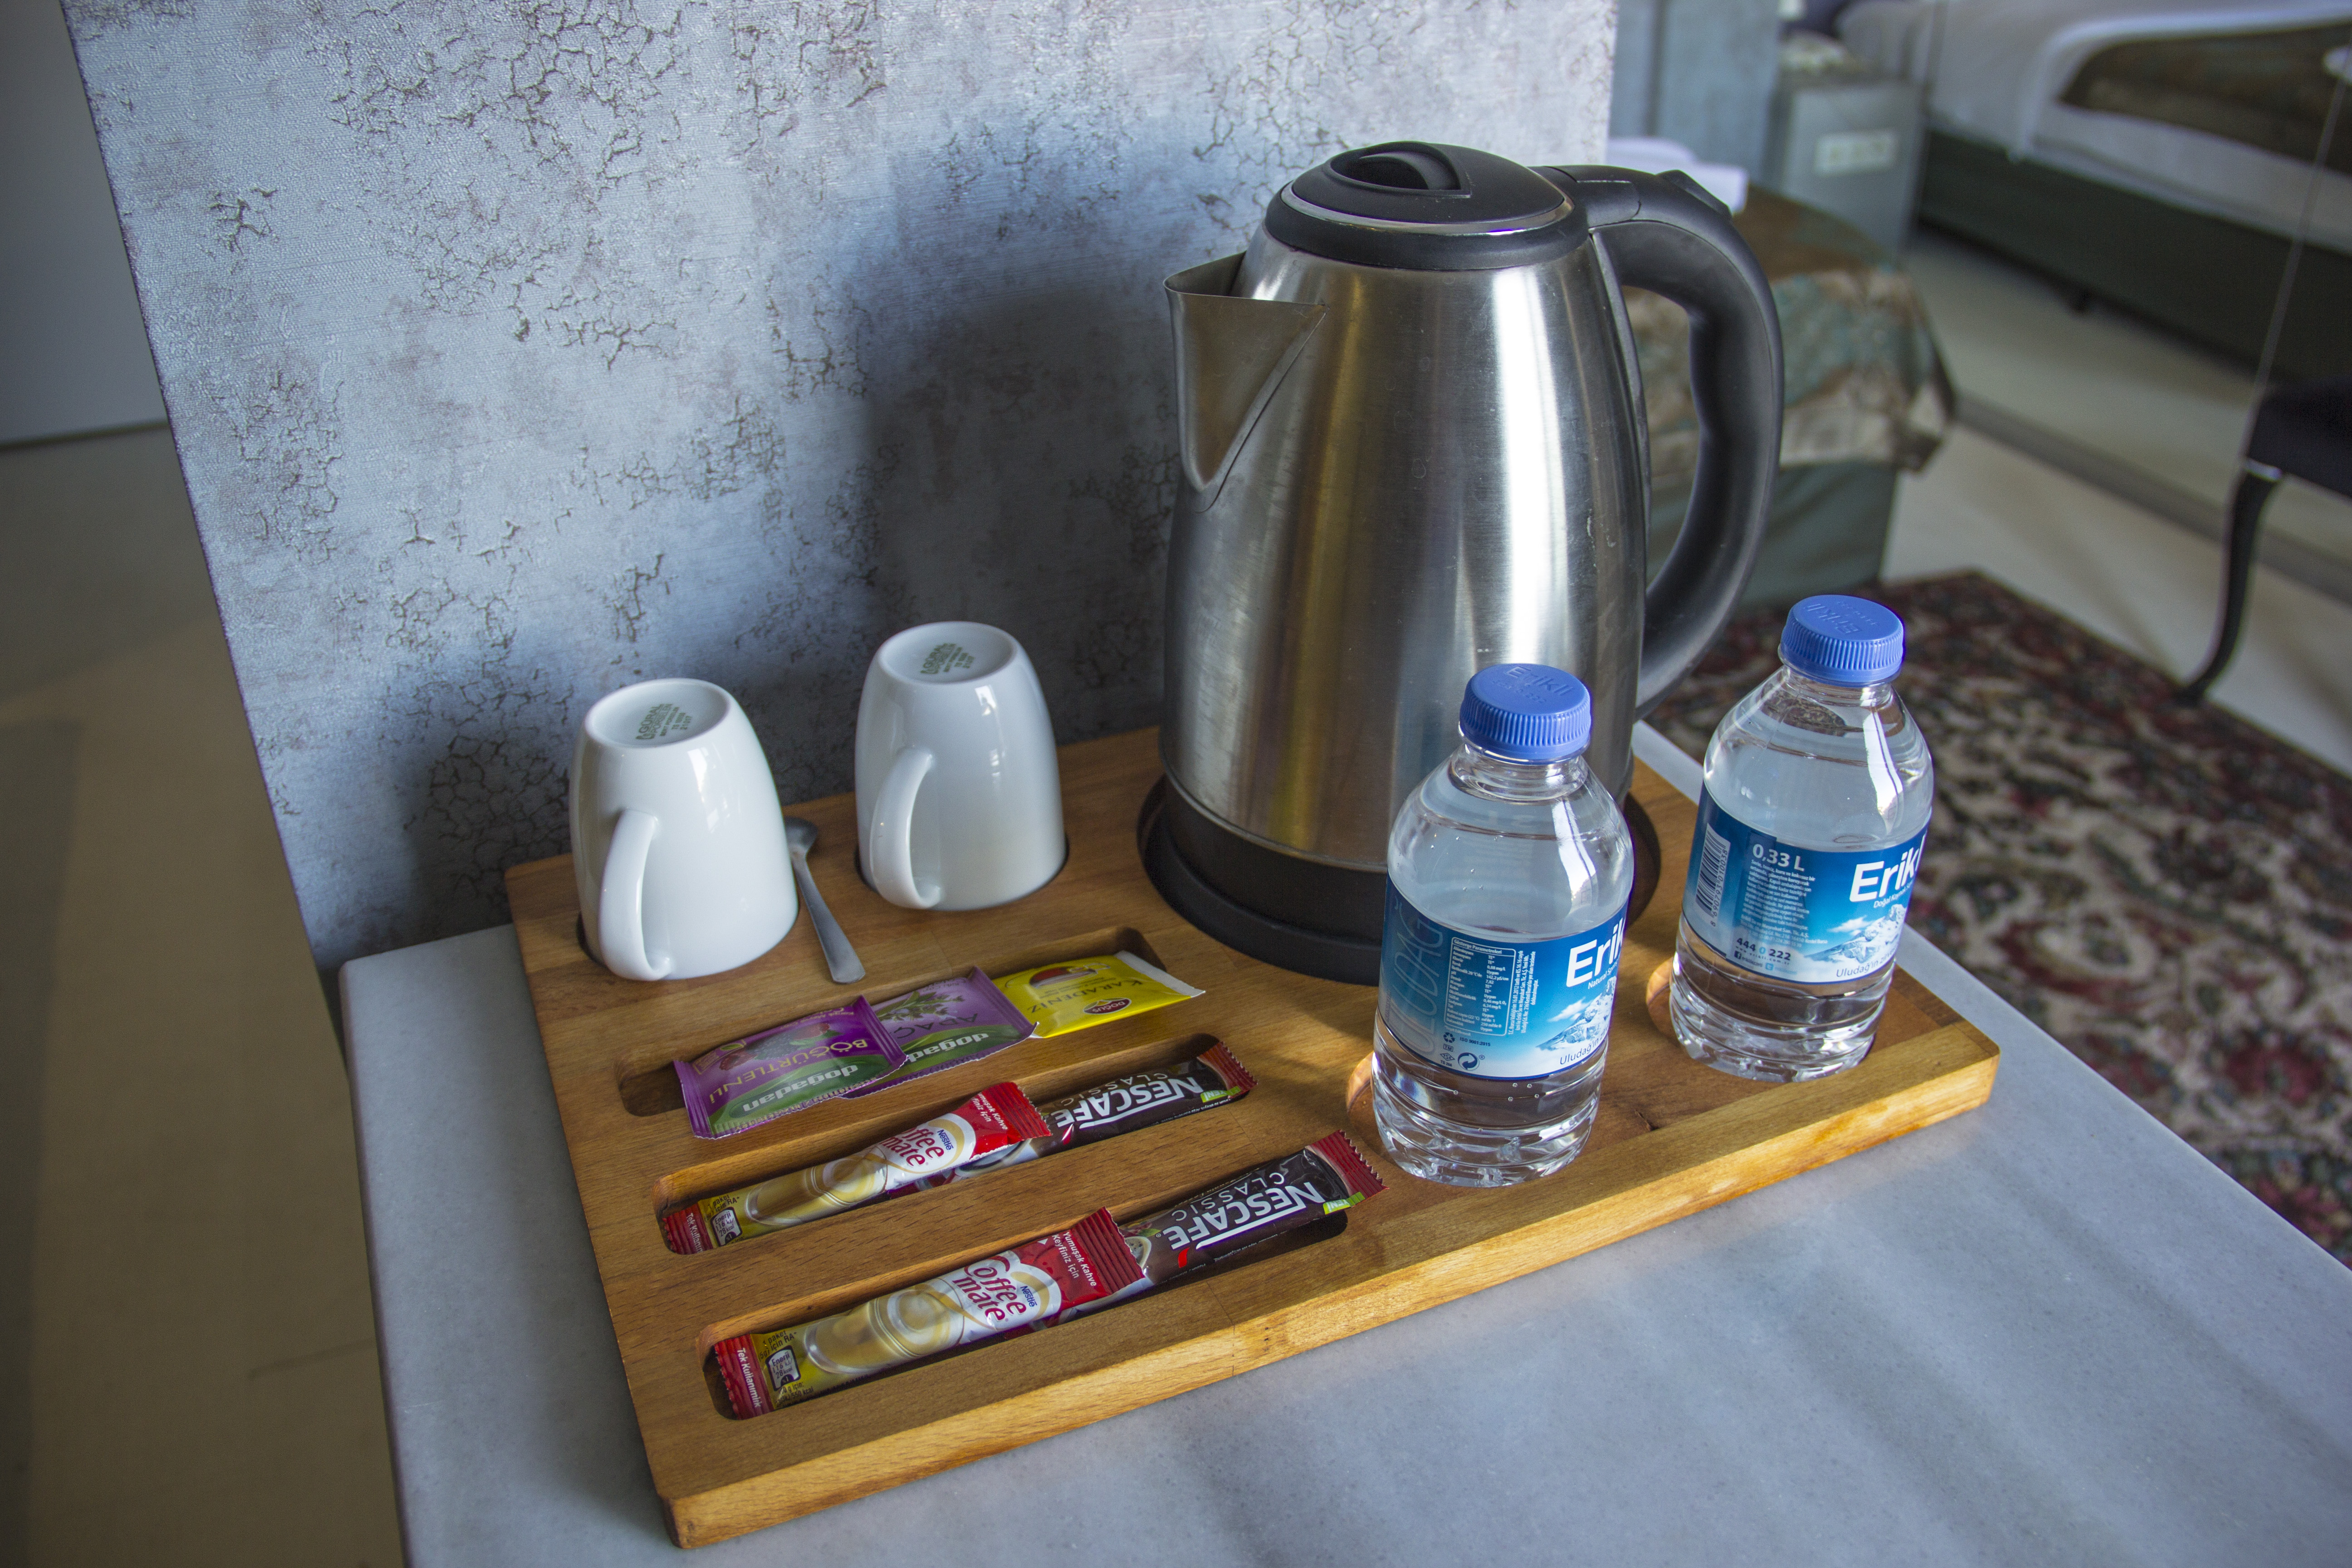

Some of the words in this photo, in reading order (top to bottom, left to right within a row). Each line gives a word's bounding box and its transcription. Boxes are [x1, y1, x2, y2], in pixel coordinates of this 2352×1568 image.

[1752, 844, 1790, 867] 0,33
[1793, 857, 1805, 872] L
[1472, 945, 1503, 955] Parametreleri
[1736, 936, 1756, 952] 444
[1759, 946, 1766, 955] 0
[1769, 947, 1791, 961] 222
[1588, 970, 1607, 989] Natural
[1027, 980, 1143, 1013] KARADENİZ
[1560, 1036, 1600, 1066] Uludağ'ın
[710, 1039, 868, 1103] BÖĞÜRTLENLİ
[743, 1065, 858, 1112] doğadan
[1061, 1073, 1168, 1106] CLASSIC
[971, 1098, 984, 1110] finiz
[980, 1111, 992, 1122] için
[992, 1113, 1008, 1130] Kahve
[879, 1137, 926, 1166] mate
[902, 1127, 944, 1158] ffee
[1171, 1172, 1285, 1222] CLASSIC
[686, 1213, 695, 1226] Tek
[715, 1211, 731, 1224] Enerji
[715, 1220, 725, 1231] 116
[1052, 1235, 1071, 1263] Keyfiniz
[1068, 1264, 1079, 1278] için
[1063, 1232, 1084, 1263] Yumuşak
[1080, 1264, 1097, 1286] Kahve
[964, 1255, 1026, 1314] Coffee
[952, 1277, 1005, 1321] mate
[768, 1331, 787, 1343] paket
[770, 1340, 783, 1351] için
[737, 1348, 748, 1362] Tek
[771, 1351, 790, 1367] Enerji
[772, 1364, 783, 1373] 116
[741, 1363, 762, 1407] Kullanımlık
[803, 1387, 814, 1395] kcal
